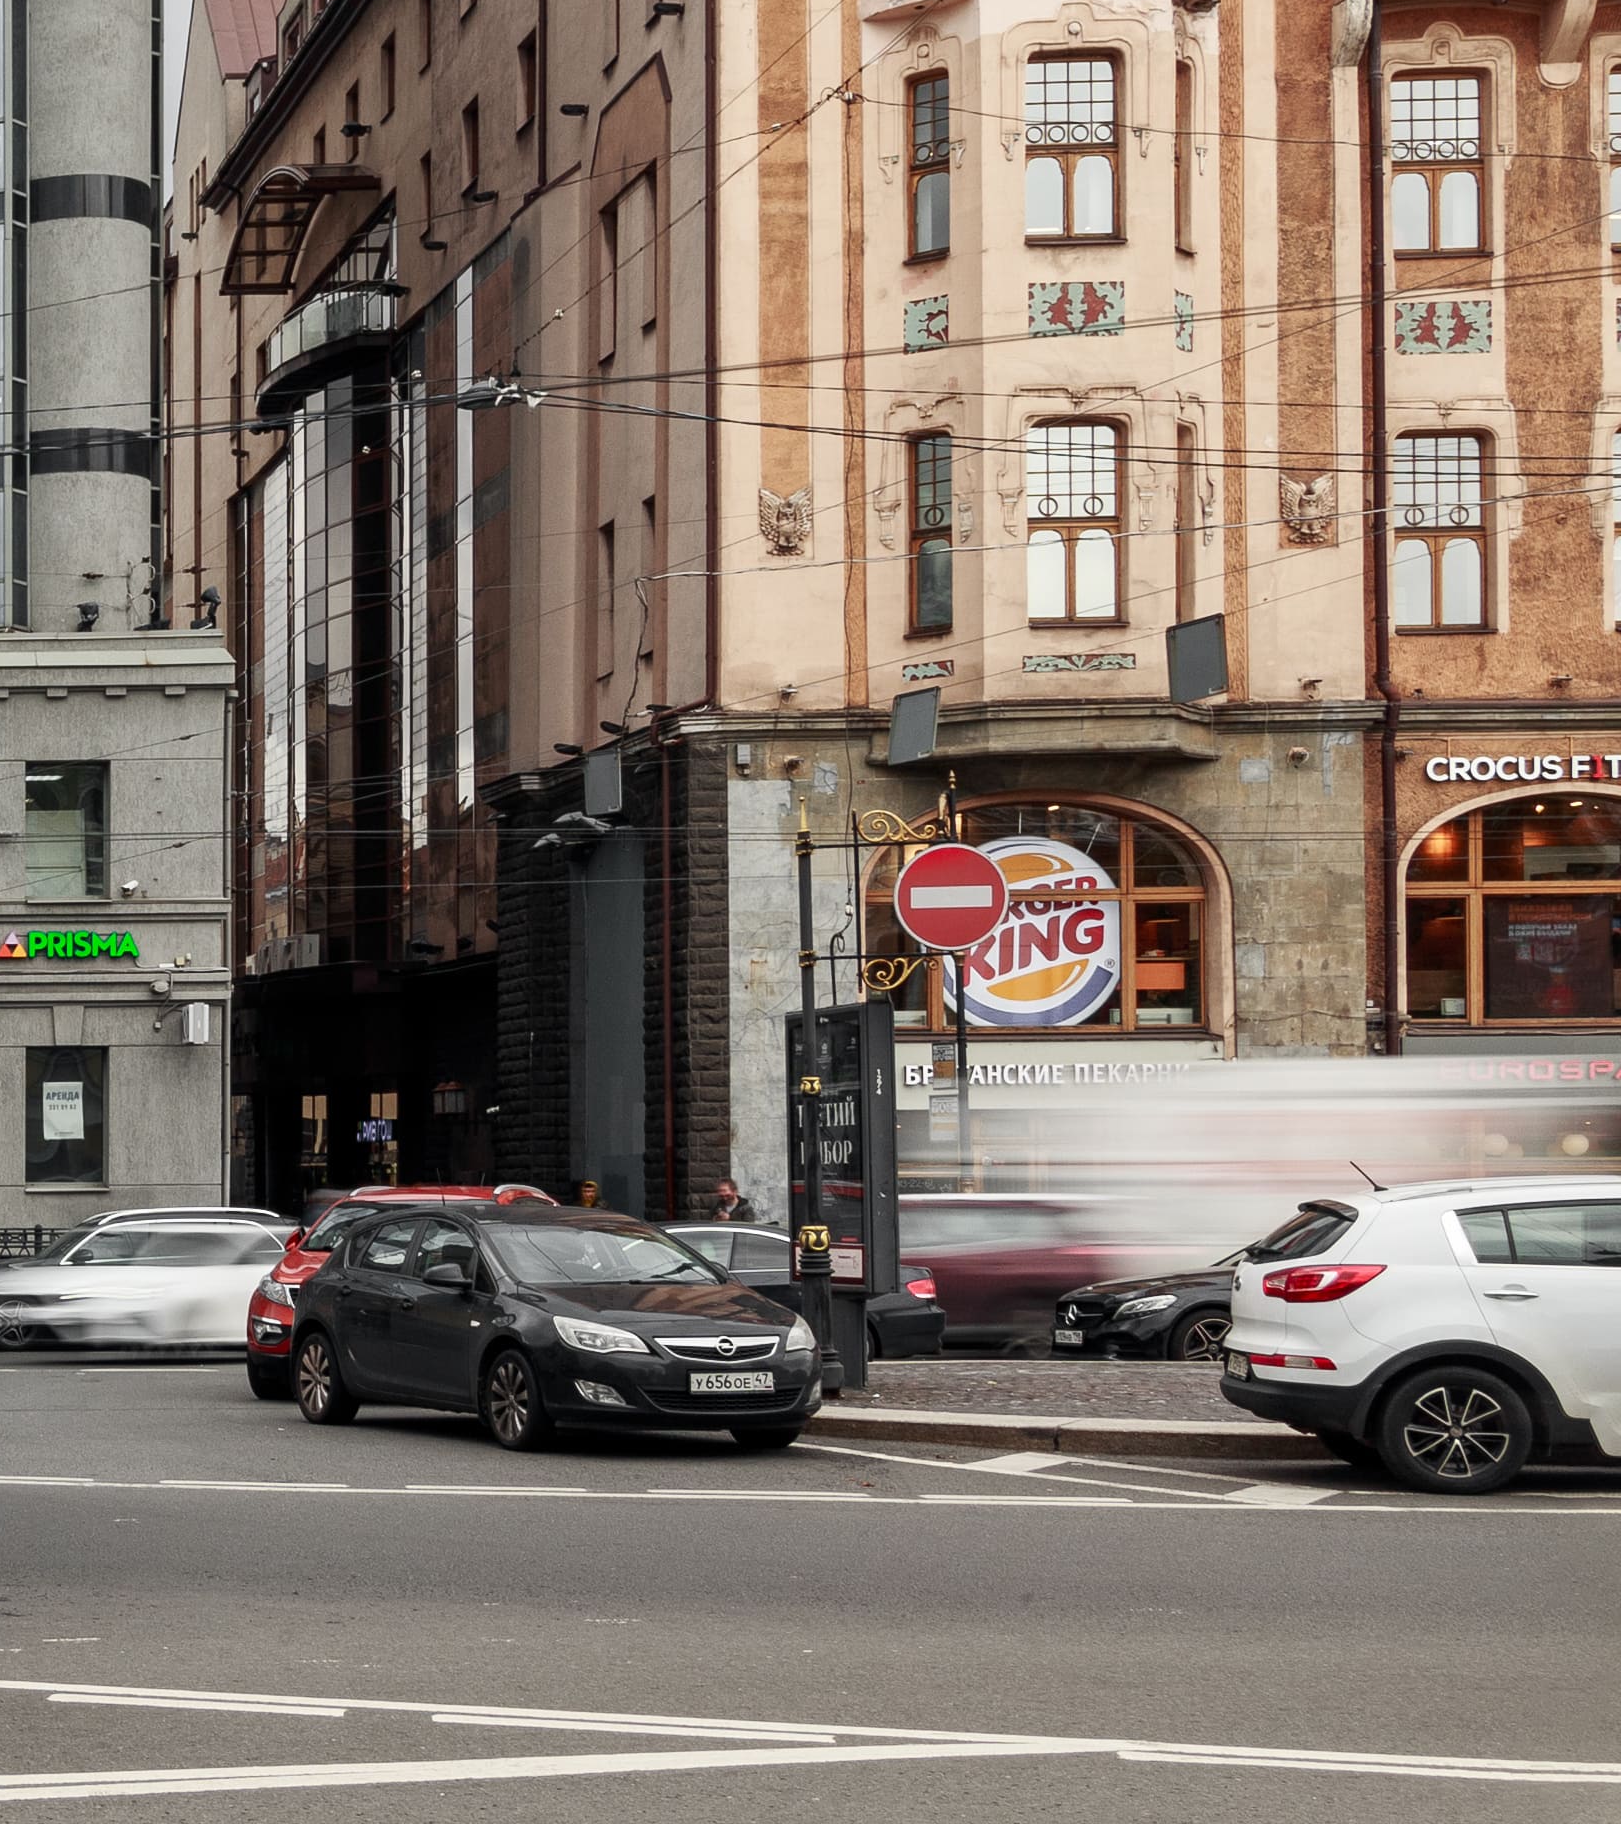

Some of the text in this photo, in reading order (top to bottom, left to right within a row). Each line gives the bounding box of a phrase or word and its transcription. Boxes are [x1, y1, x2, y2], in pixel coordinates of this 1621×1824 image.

[1426, 755, 1564, 781] CROCUS
[28, 930, 140, 959] PRISMA
[963, 908, 1105, 988] KING
[905, 1063, 1063, 1085] БРАНСКИЕ
[46, 1091, 79, 1101] АРЕНДА
[796, 1096, 856, 1128] ТТИЙ
[800, 1140, 853, 1165] БОР
